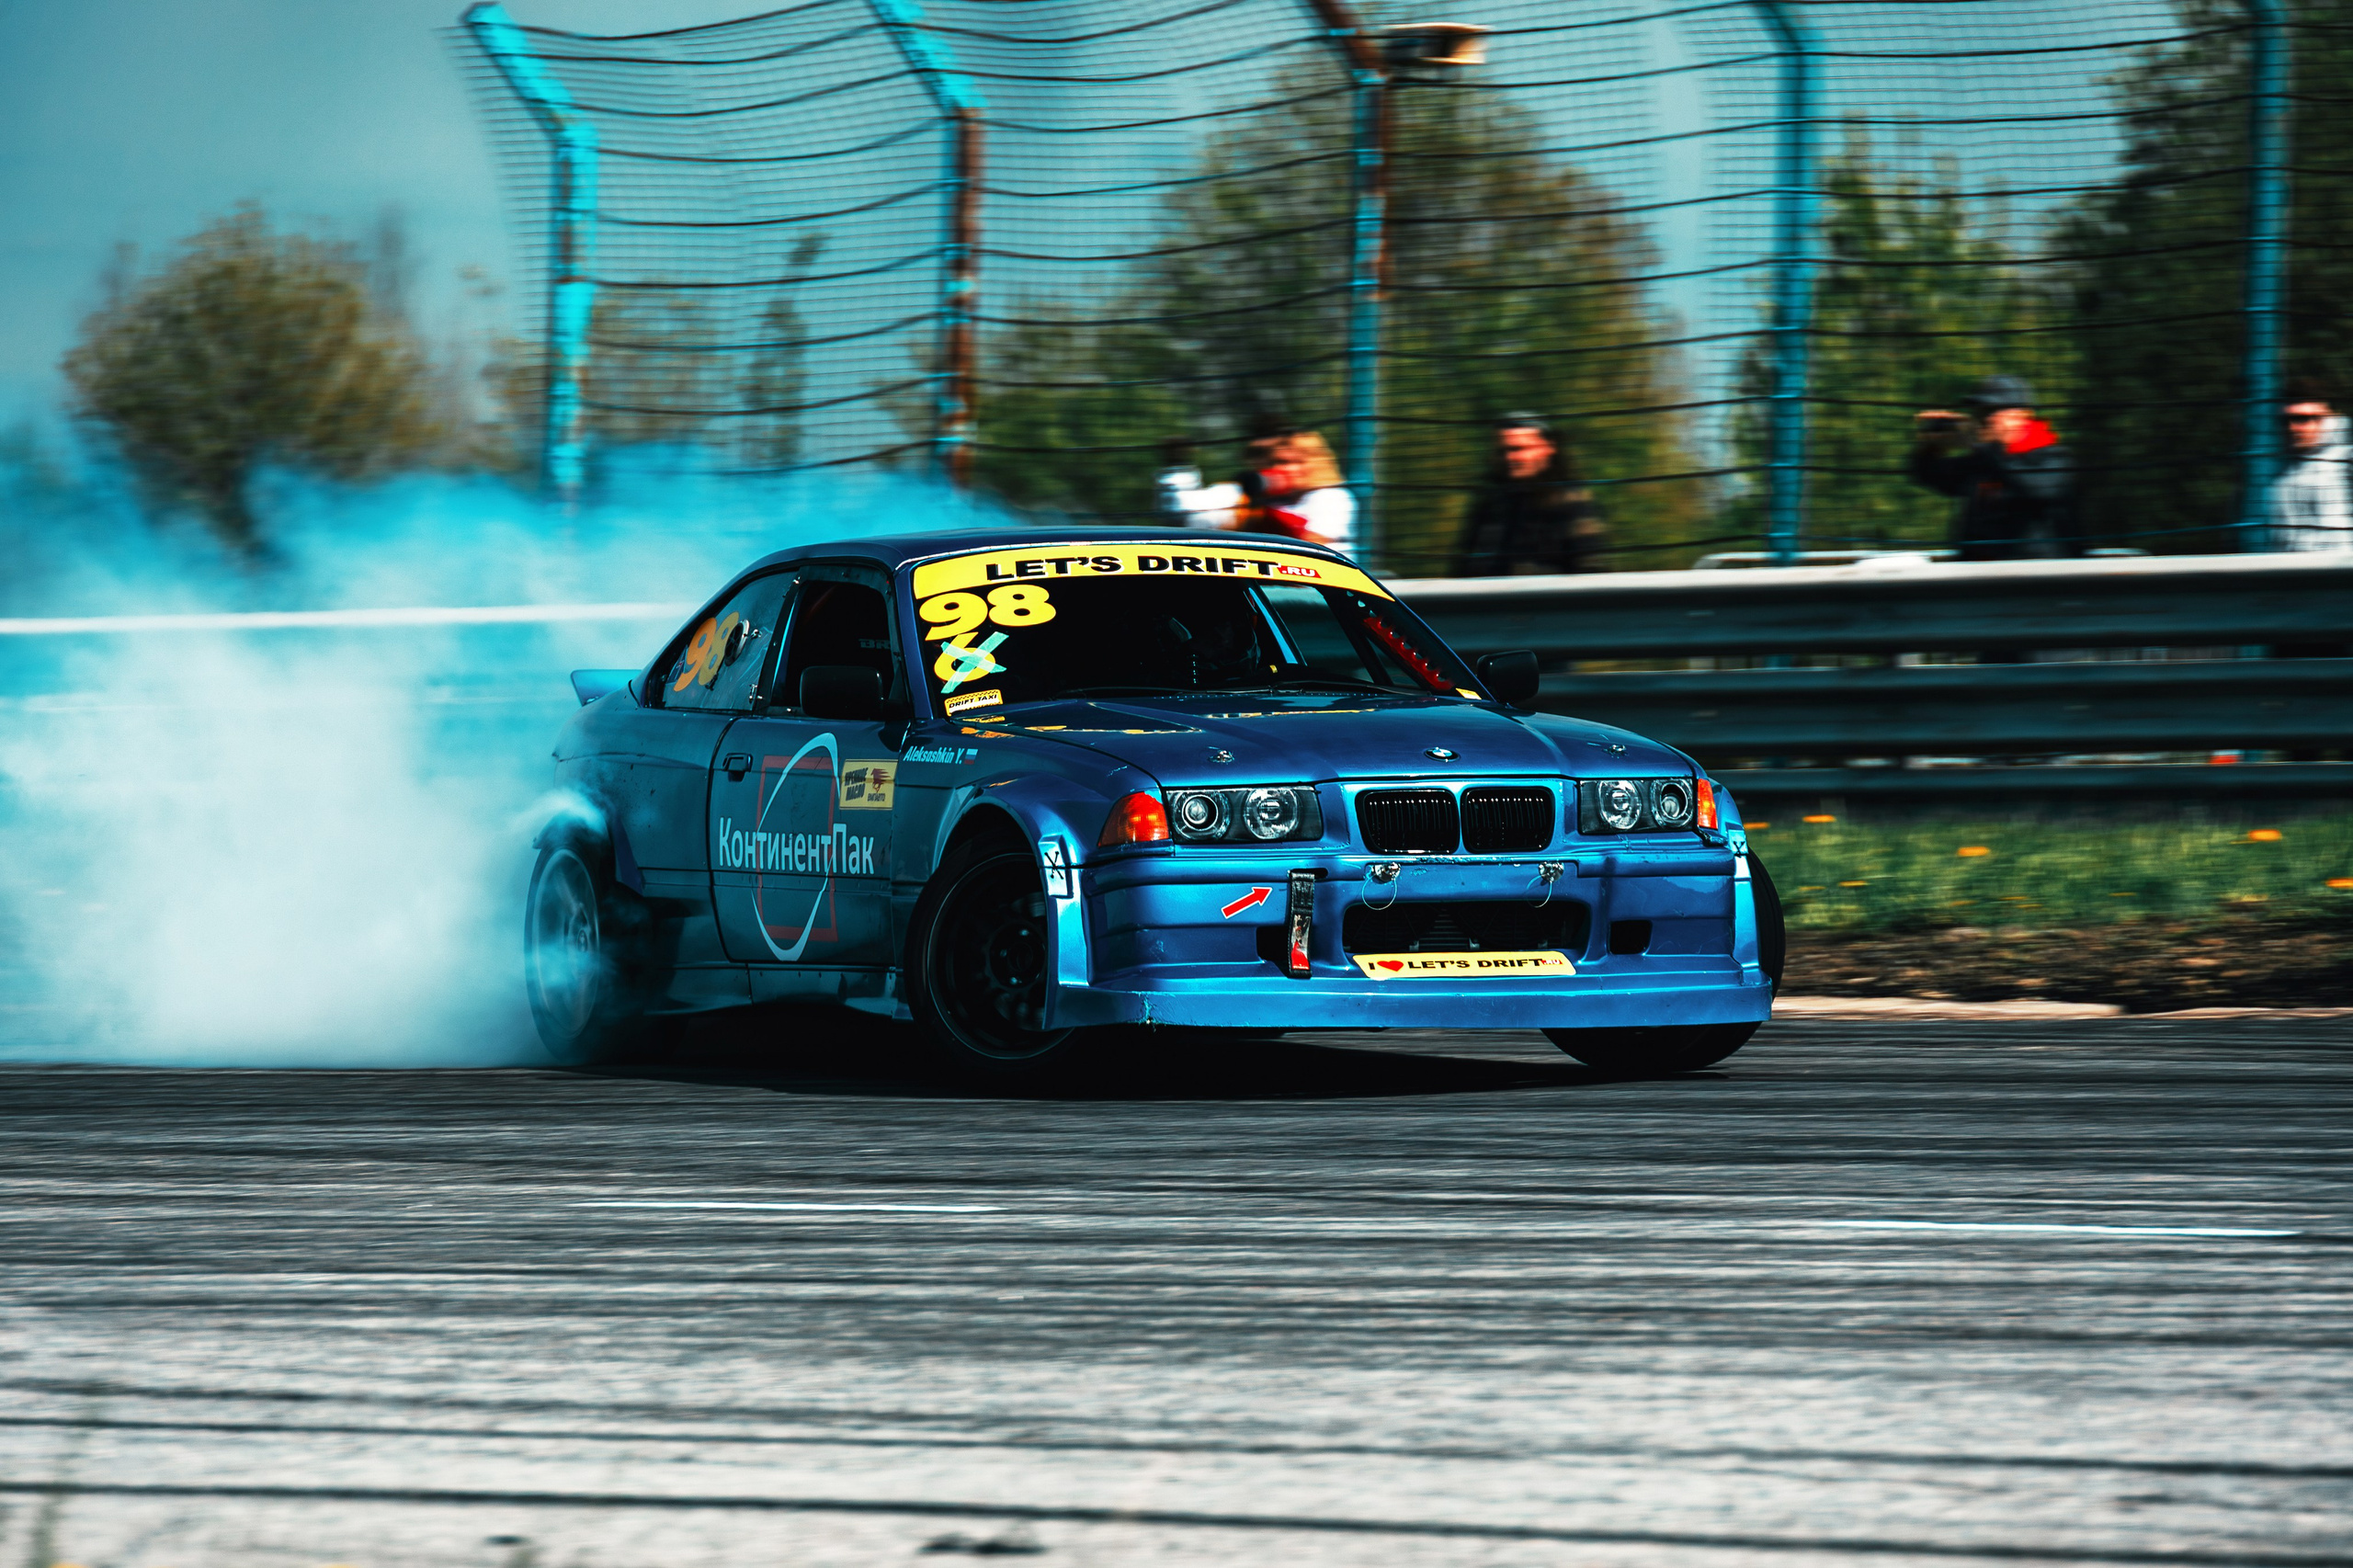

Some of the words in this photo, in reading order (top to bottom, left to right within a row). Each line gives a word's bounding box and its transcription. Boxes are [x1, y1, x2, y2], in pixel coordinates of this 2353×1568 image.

[985, 555, 1122, 581] LET'S
[919, 584, 1056, 641] 98
[673, 611, 739, 692] 98
[949, 699, 974, 709] DRIFT
[903, 745, 955, 764] Aleksashkin
[719, 817, 874, 874] КонтинентПак
[1407, 960, 1471, 970] LET'S
